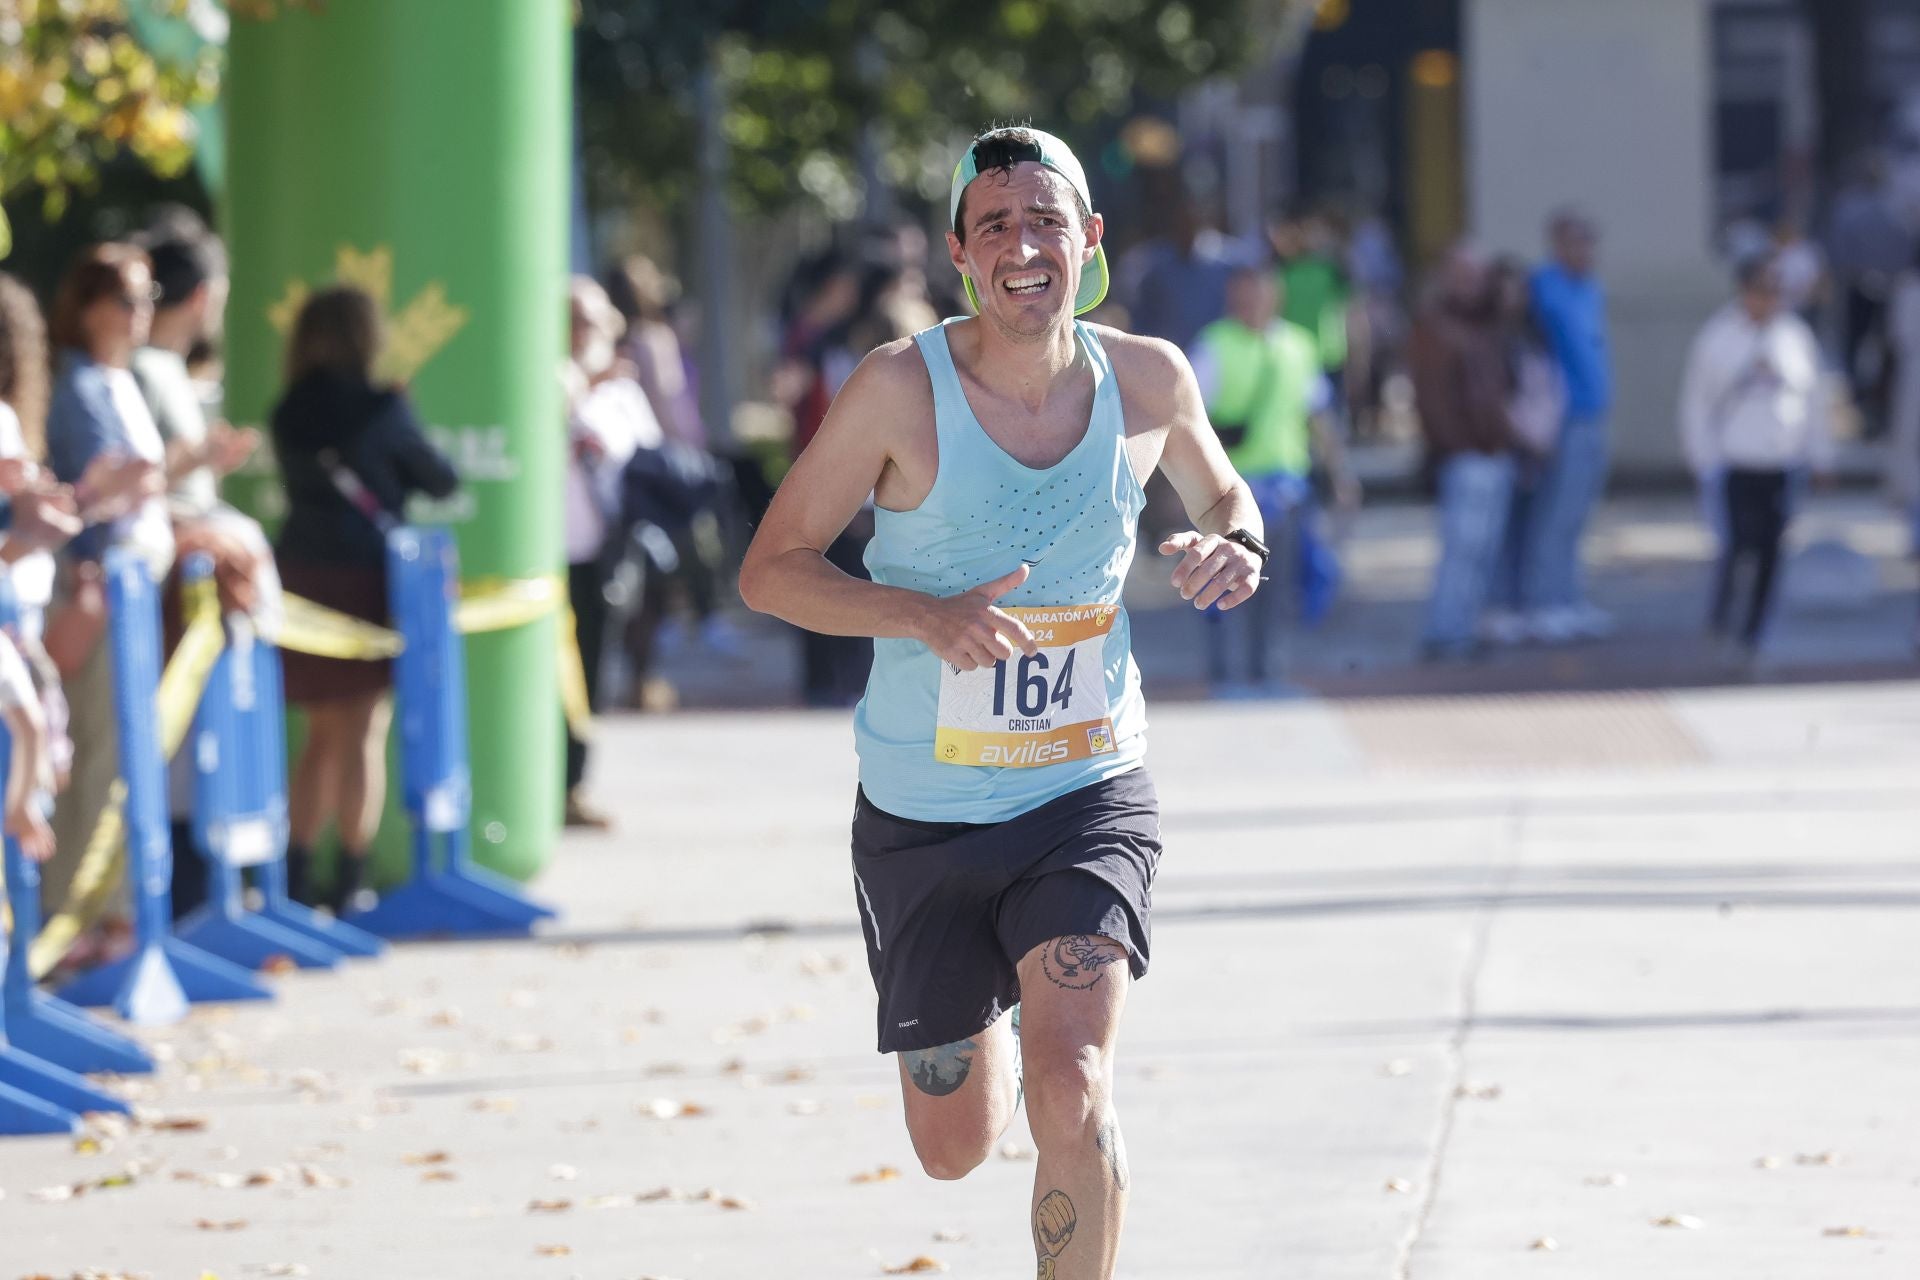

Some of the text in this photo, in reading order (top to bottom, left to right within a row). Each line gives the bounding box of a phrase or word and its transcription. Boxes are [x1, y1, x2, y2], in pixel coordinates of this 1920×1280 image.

[1023, 609, 1081, 623] MARATÓN
[993, 648, 1076, 718] 164
[1008, 718, 1051, 732] CRISTIAN
